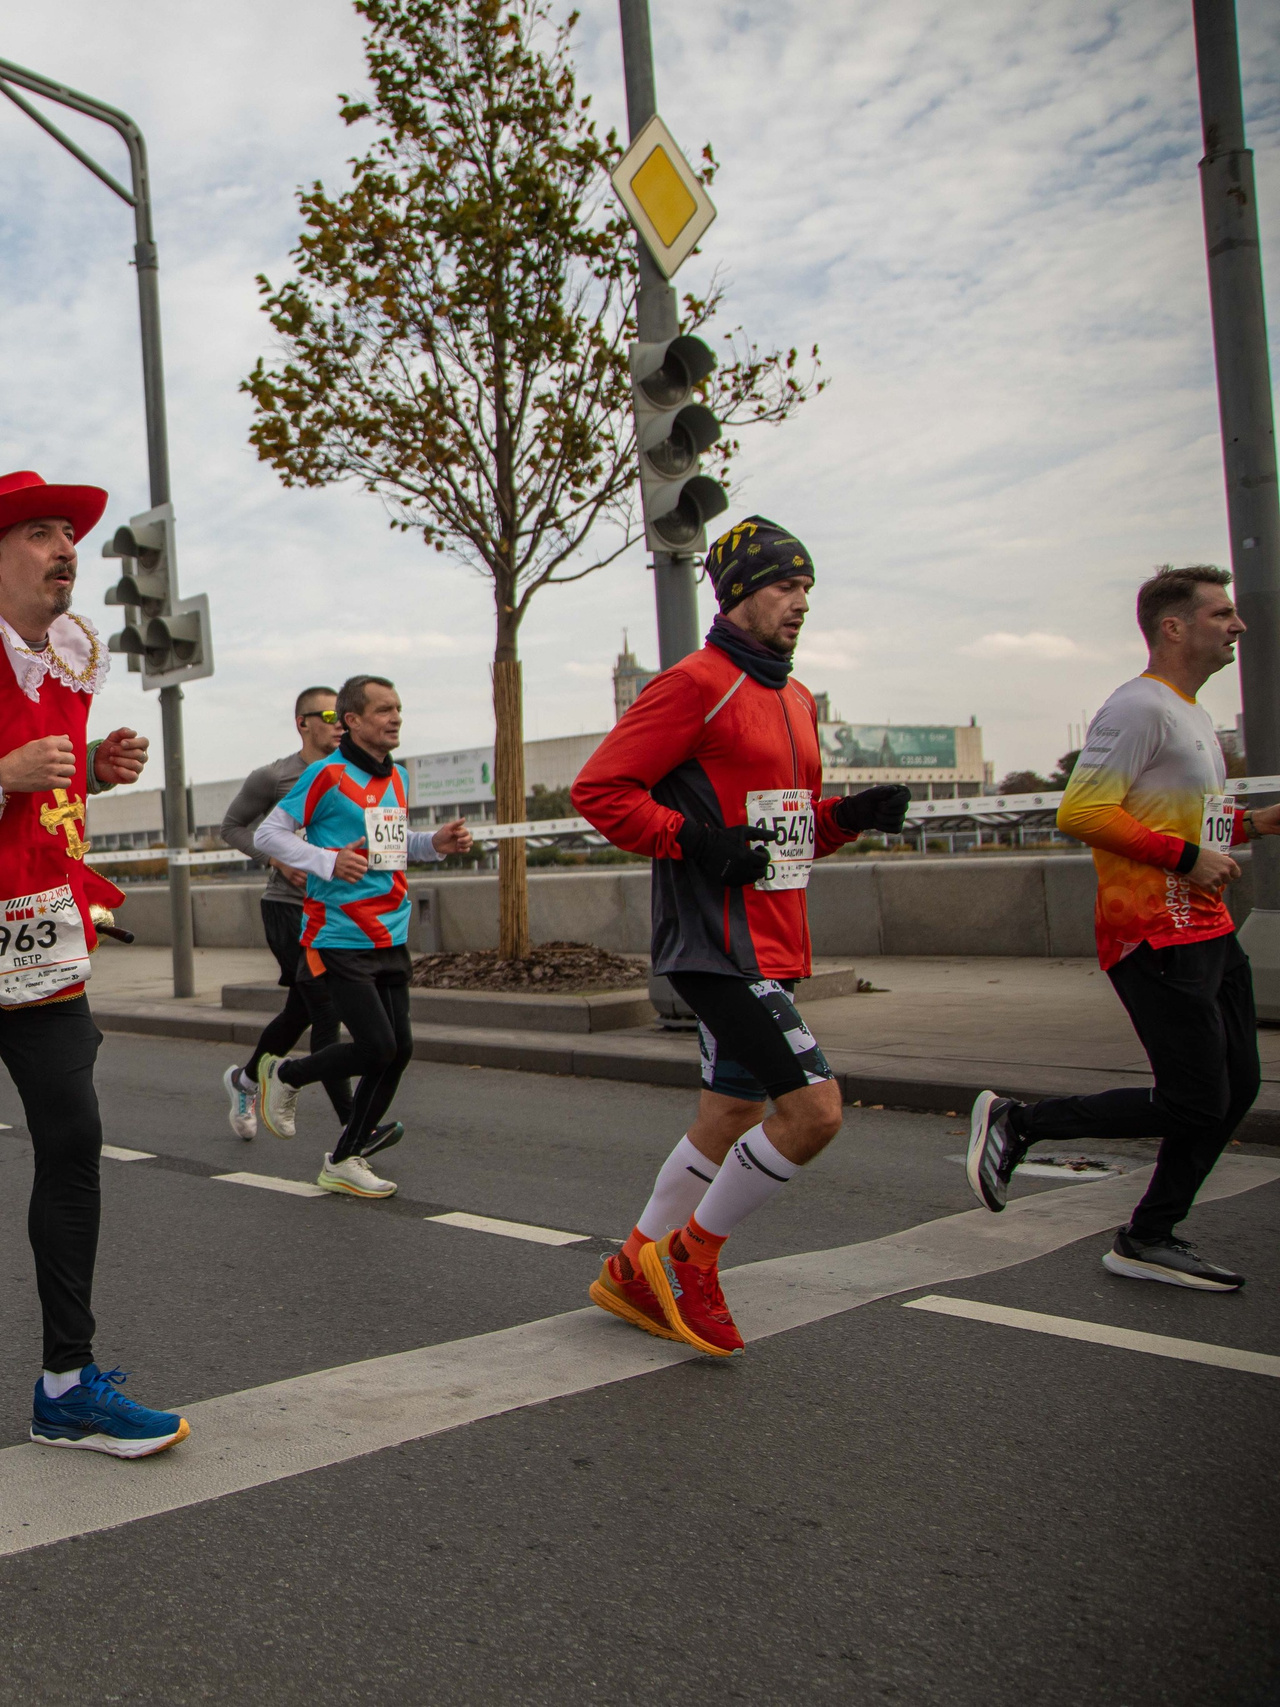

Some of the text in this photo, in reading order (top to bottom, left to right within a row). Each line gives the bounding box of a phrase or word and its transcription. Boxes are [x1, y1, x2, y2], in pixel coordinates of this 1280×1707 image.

[374, 824, 405, 843] 6145
[755, 815, 814, 847] 15476
[1206, 816, 1234, 843] 109
[373, 853, 382, 865] D
[780, 848, 804, 858] МАКСИМ
[35, 890, 55, 904] 42,2
[13, 953, 42, 967] ПЕТР
[660, 1255, 684, 1300] HOKA
